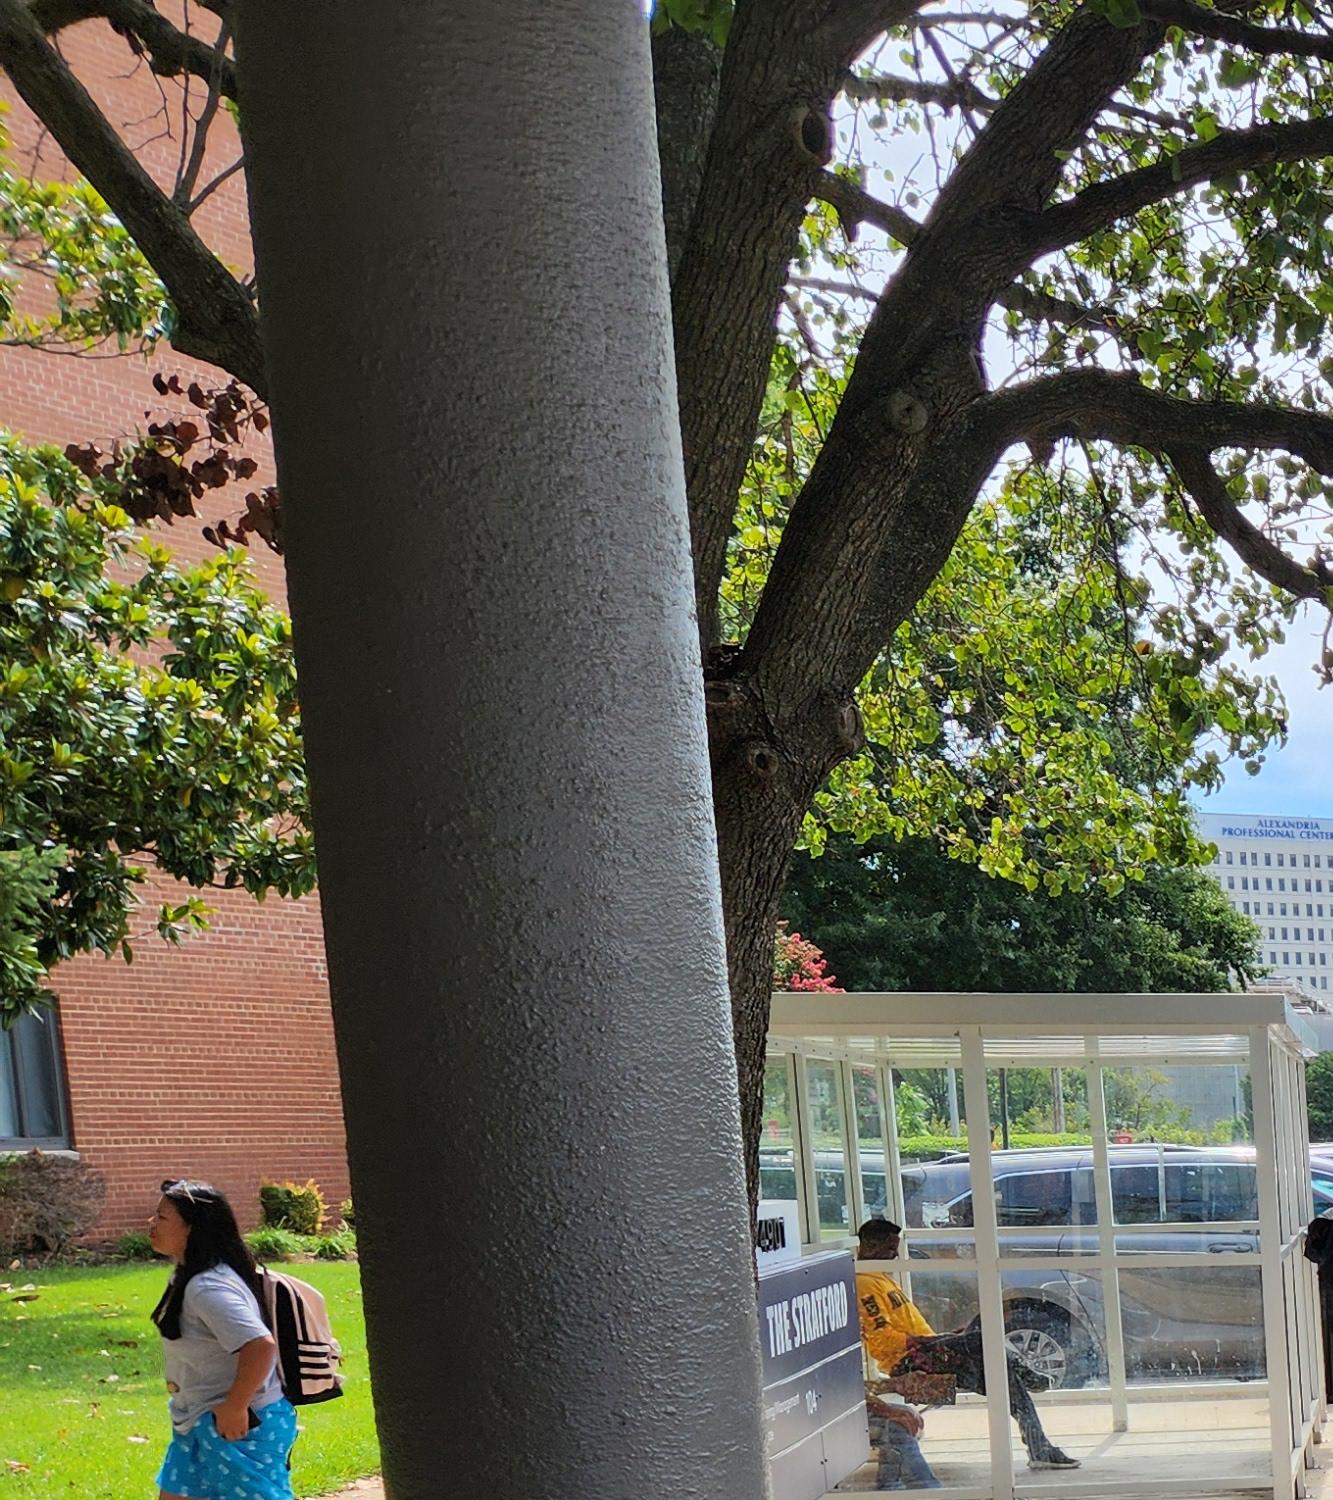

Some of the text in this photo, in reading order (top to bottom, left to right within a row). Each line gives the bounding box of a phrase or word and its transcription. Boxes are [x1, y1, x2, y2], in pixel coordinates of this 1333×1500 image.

[1258, 819, 1320, 830] ALEXANDRIA
[1222, 827, 1295, 839] PROFESSIONAL
[765, 1300, 793, 1358] THE
[791, 1280, 848, 1349] STRATFORD
